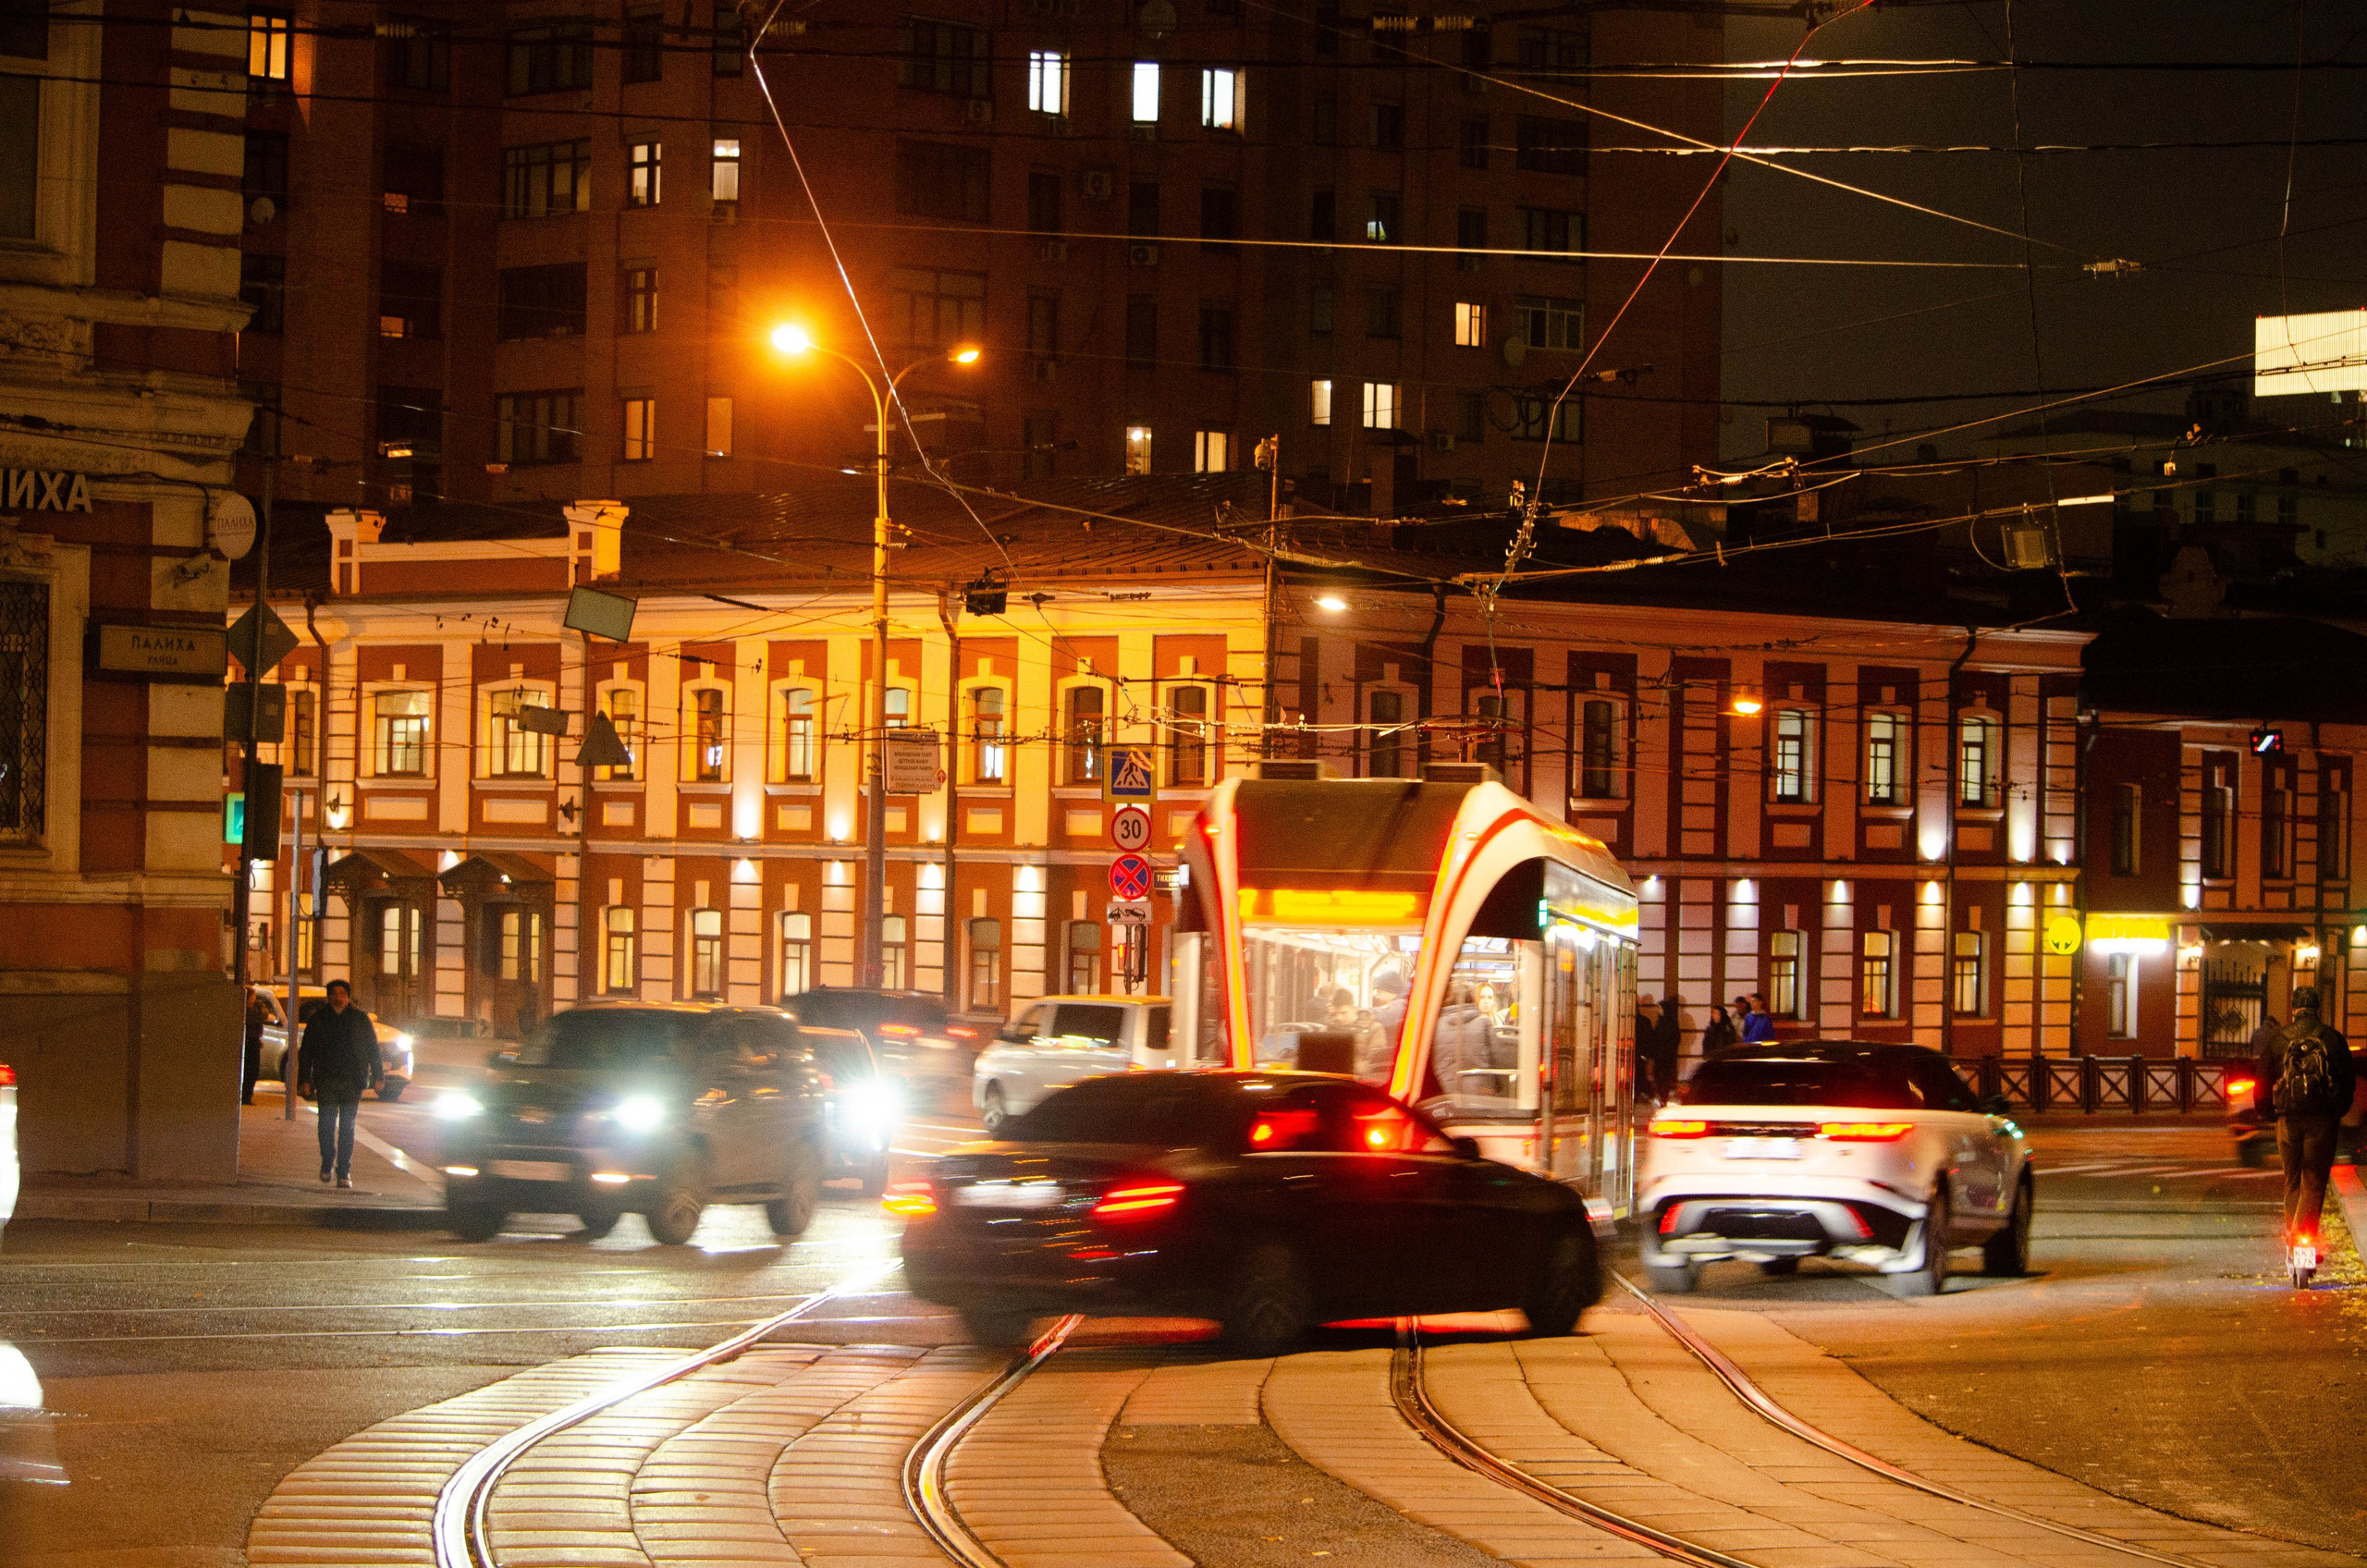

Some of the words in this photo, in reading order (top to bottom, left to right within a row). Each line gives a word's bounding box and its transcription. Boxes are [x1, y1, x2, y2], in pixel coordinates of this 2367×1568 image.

[0, 469, 92, 513] ИХА
[131, 635, 196, 652] ПАЛИХА
[1121, 819, 1141, 839] 30
